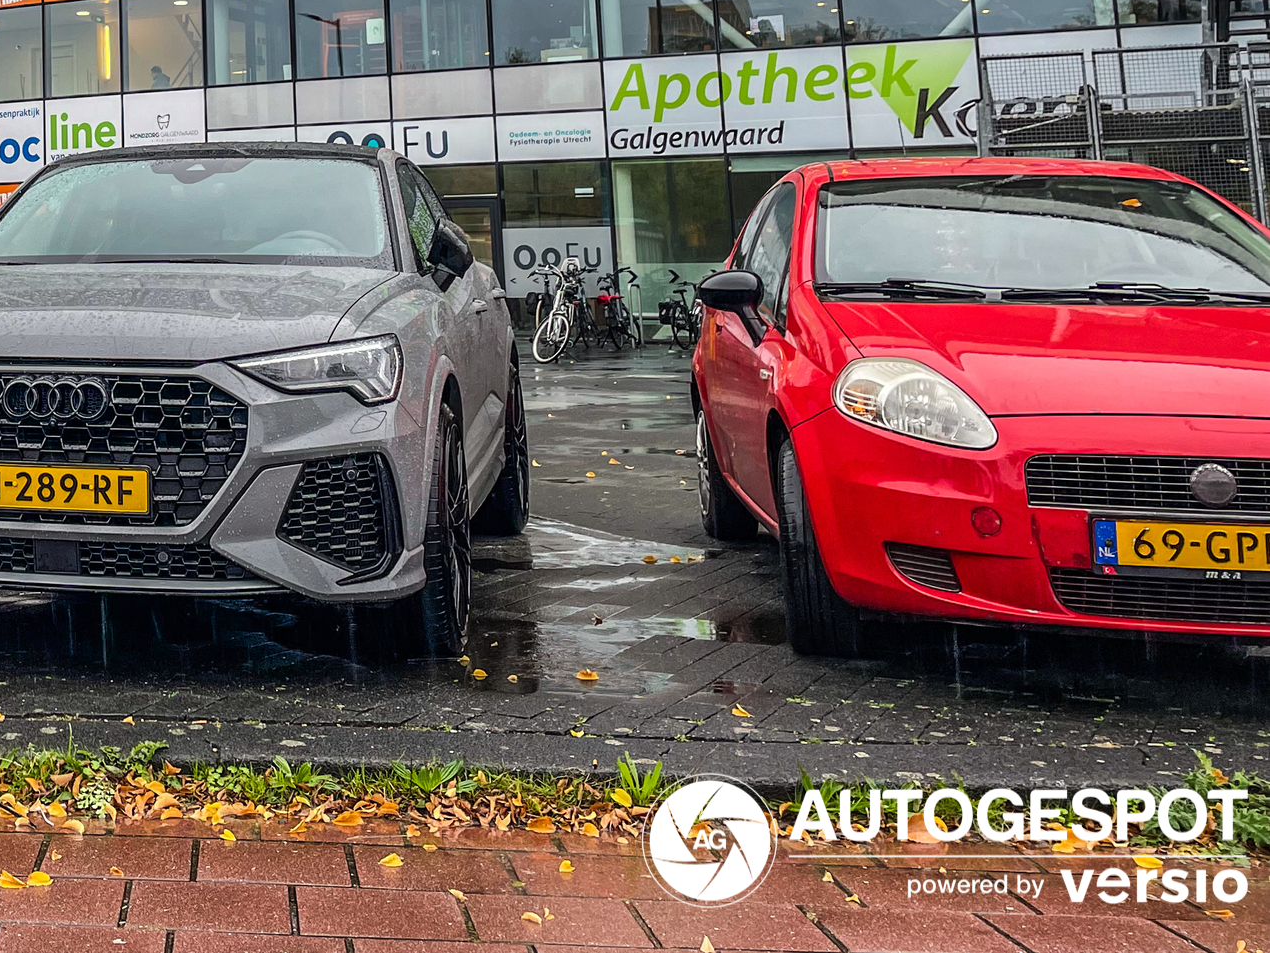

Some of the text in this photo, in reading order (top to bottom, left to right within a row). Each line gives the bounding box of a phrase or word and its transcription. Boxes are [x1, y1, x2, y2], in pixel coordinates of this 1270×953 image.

[609, 45, 918, 122] Apotheek
[50, 112, 116, 150] line
[160, 129, 199, 138] GALGENWAARD
[509, 135, 592, 146] Fysiotherapie Utrecht
[555, 128, 592, 137] Oncologie
[610, 121, 785, 156] Galgenwaard
[1098, 527, 1270, 565] NL 69-GP
